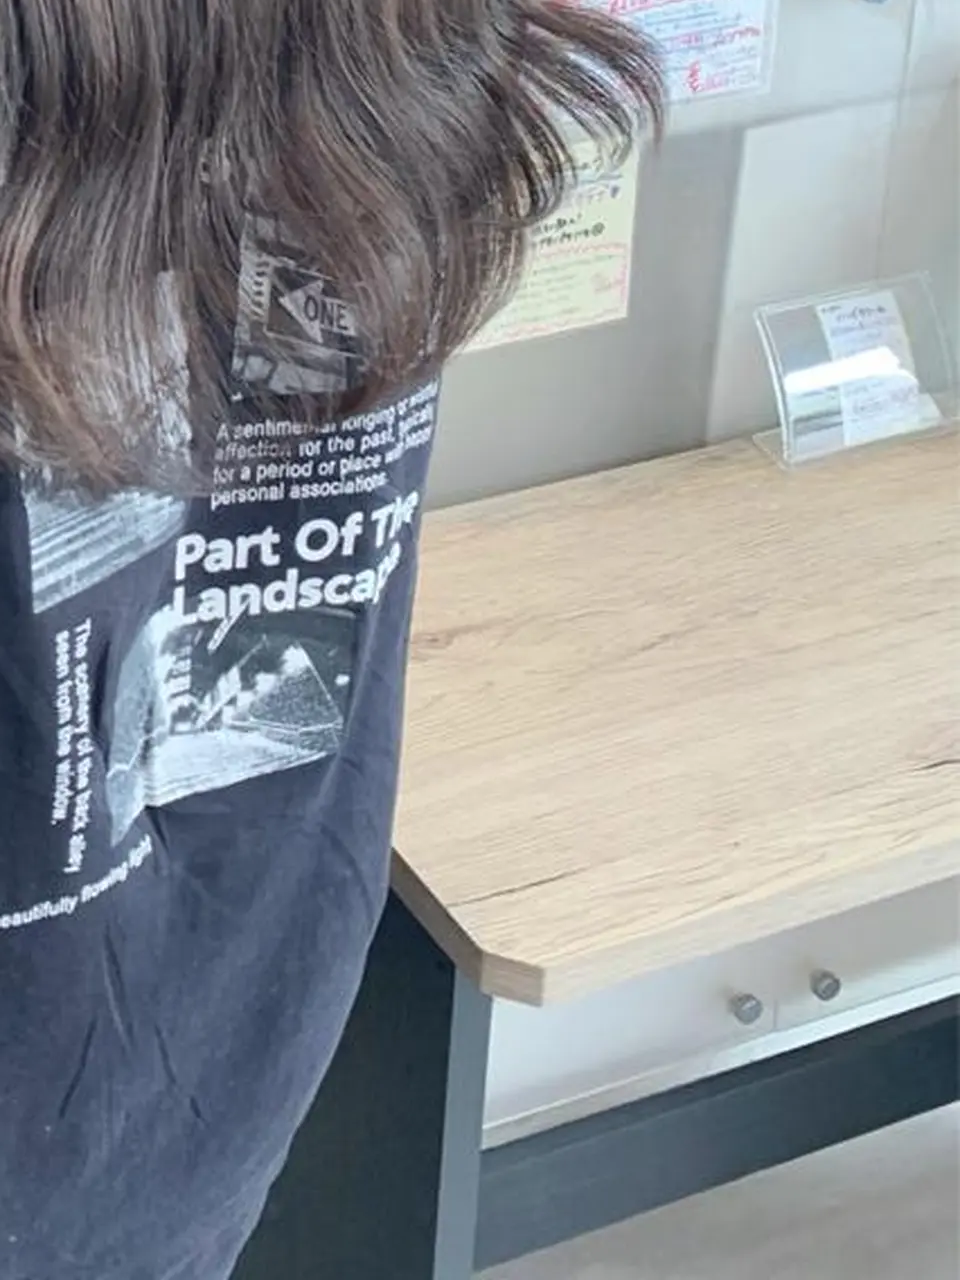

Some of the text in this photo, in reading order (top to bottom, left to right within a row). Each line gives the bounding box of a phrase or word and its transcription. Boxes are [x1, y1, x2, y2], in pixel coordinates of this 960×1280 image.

[304, 294, 350, 331] ONE
[327, 433, 356, 454] the
[239, 462, 252, 477] a
[255, 455, 313, 483] period
[340, 453, 382, 481] place
[210, 485, 285, 512] personal
[175, 524, 282, 581] Part
[294, 510, 365, 562] Of
[73, 617, 92, 659] The
[56, 680, 73, 725] from
